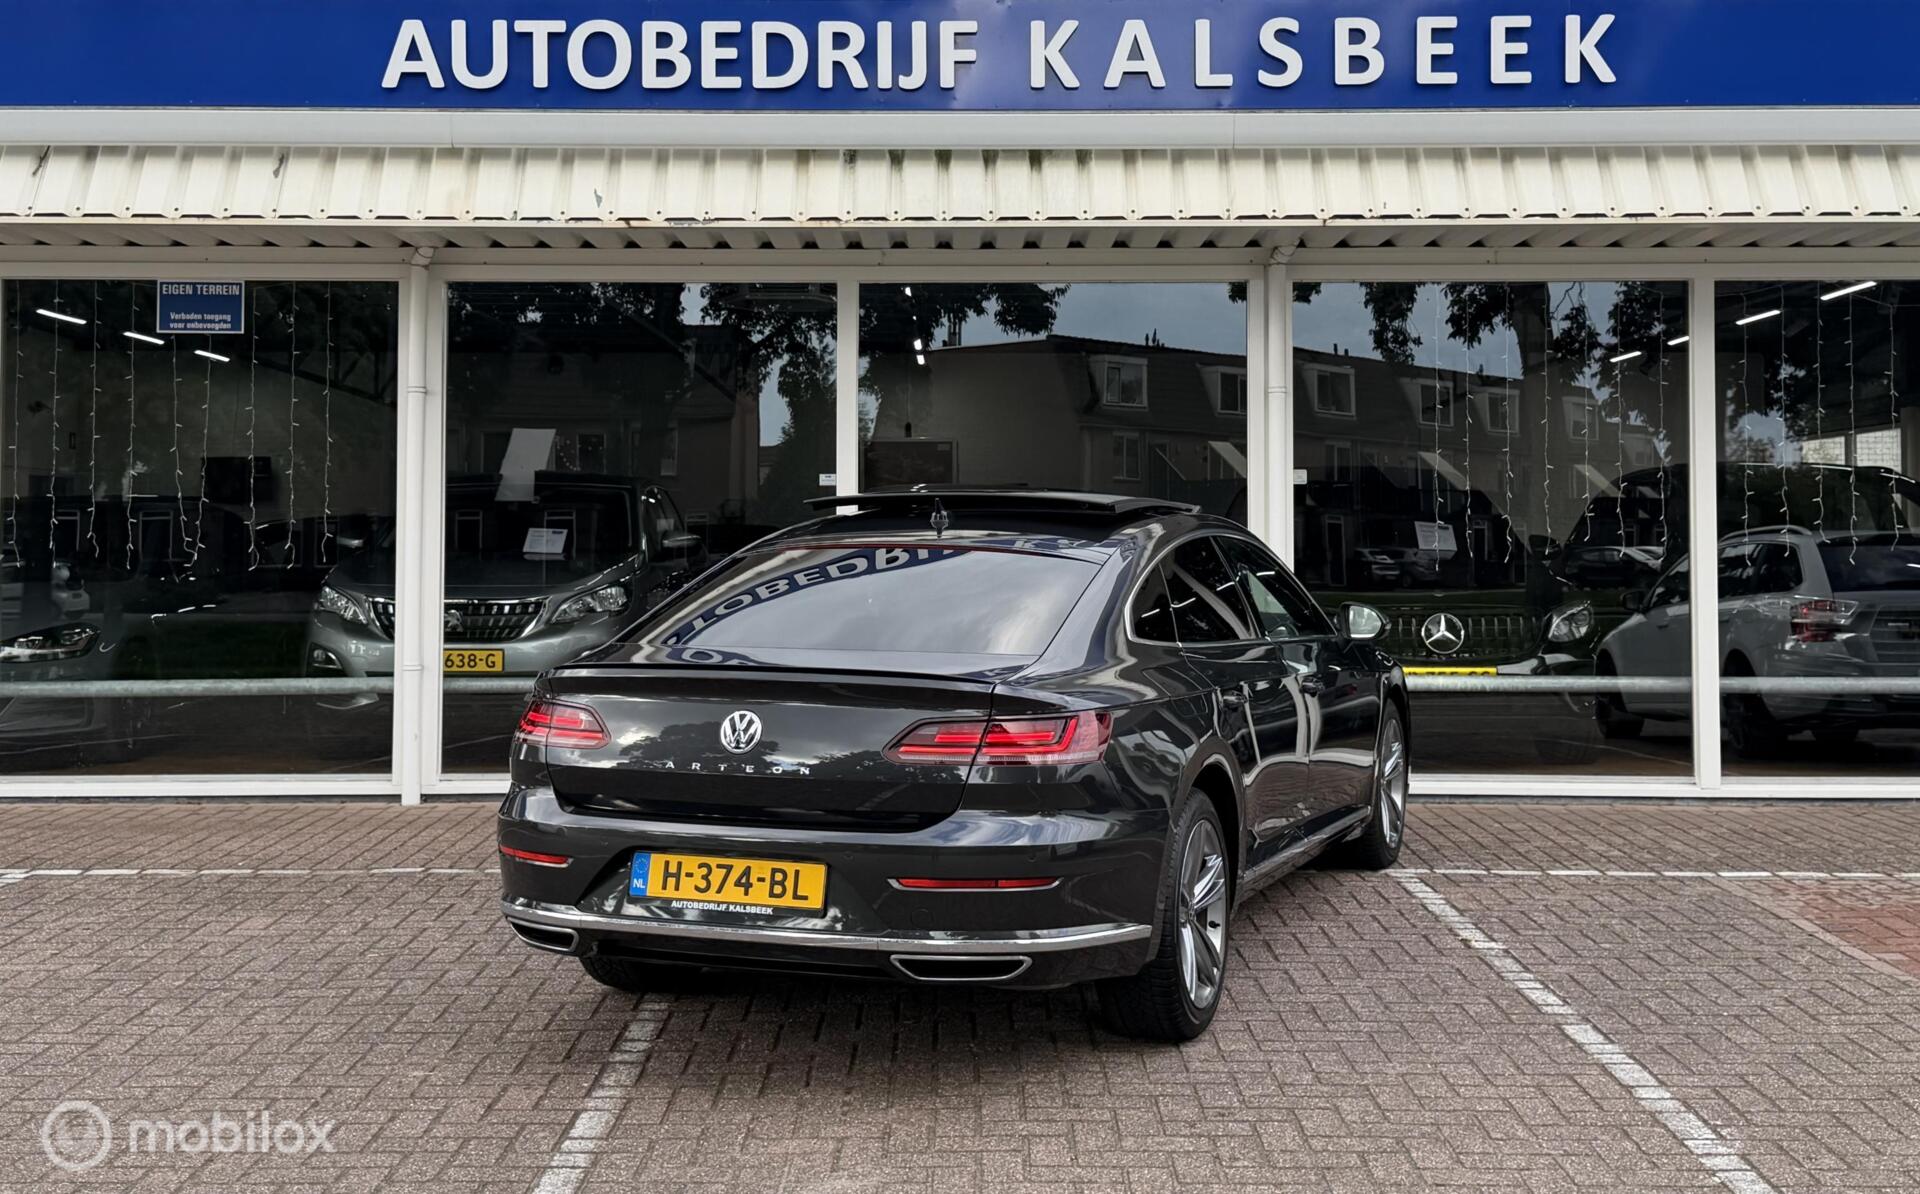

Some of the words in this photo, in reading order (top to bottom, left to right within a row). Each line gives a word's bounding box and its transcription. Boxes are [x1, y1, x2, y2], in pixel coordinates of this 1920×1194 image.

[381, 19, 979, 90] AUTOBEDRIJF
[1029, 14, 1617, 89] KALSBEEK
[162, 284, 193, 295] EIGEN
[196, 284, 240, 295] TERREIN
[170, 312, 202, 320] Verboden
[444, 653, 496, 669] 638-G
[665, 761, 811, 776] ARTEON
[633, 878, 646, 889] NL
[661, 860, 809, 901] H-374-BL
[671, 900, 728, 911] AUTOBEDRIJF
[729, 904, 774, 915] KALSBEEK
